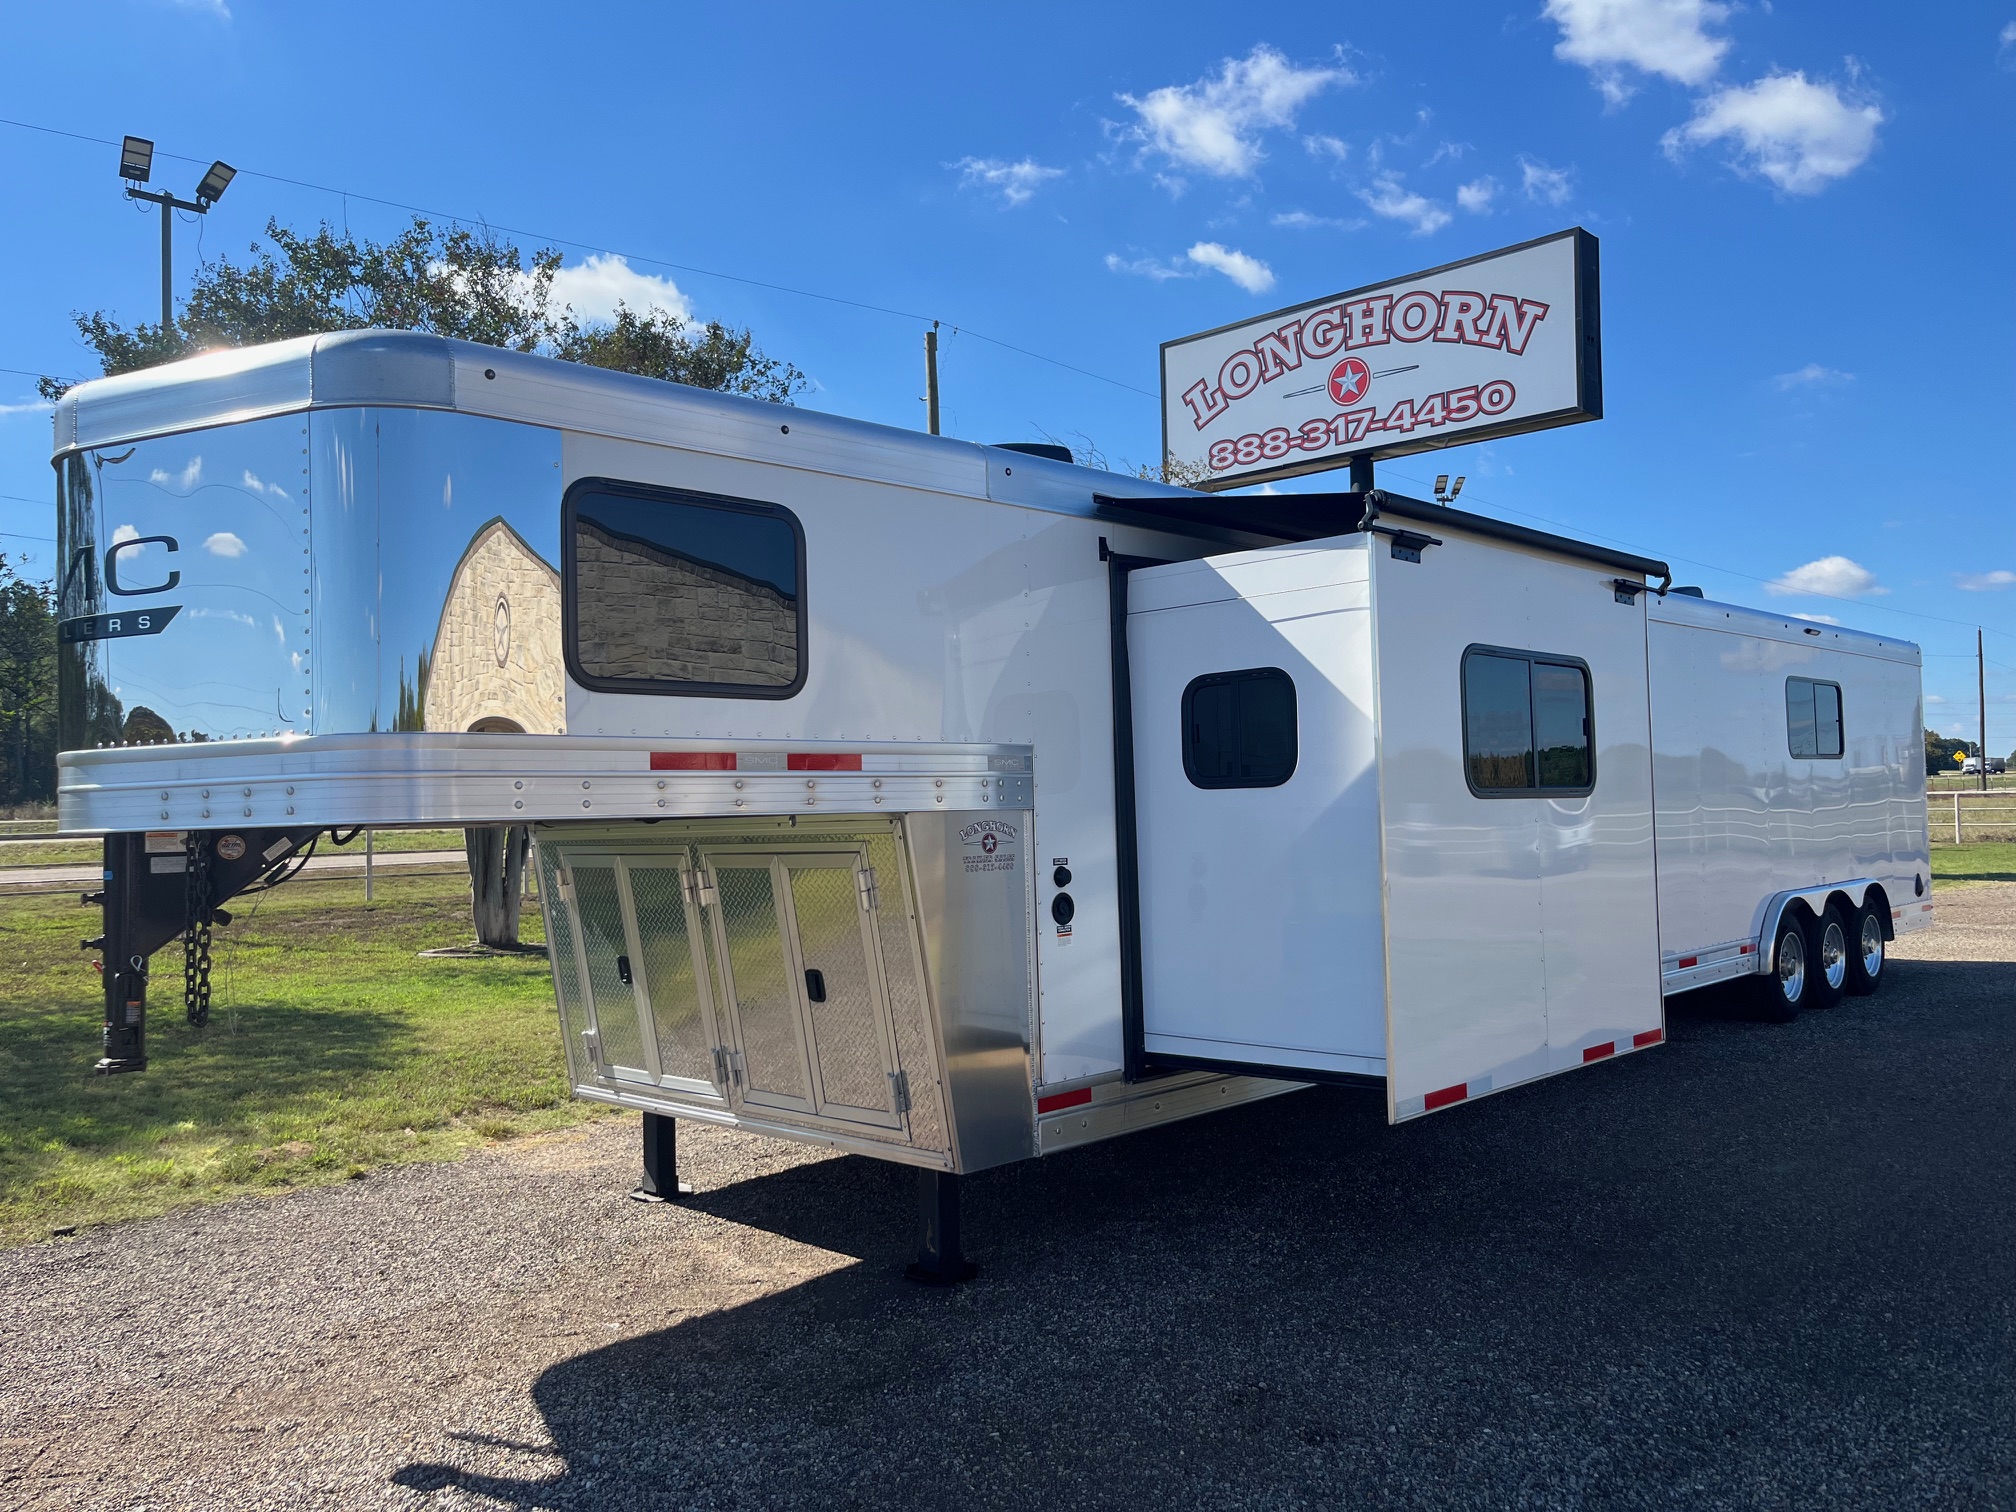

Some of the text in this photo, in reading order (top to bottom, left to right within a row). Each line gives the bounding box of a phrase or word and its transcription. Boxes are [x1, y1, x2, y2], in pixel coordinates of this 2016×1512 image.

[1182, 291, 1550, 430] LONGHORN
[1209, 380, 1516, 470] 888-317-4450
[745, 756, 778, 765] SMC
[959, 820, 1018, 841] LONGHORN
